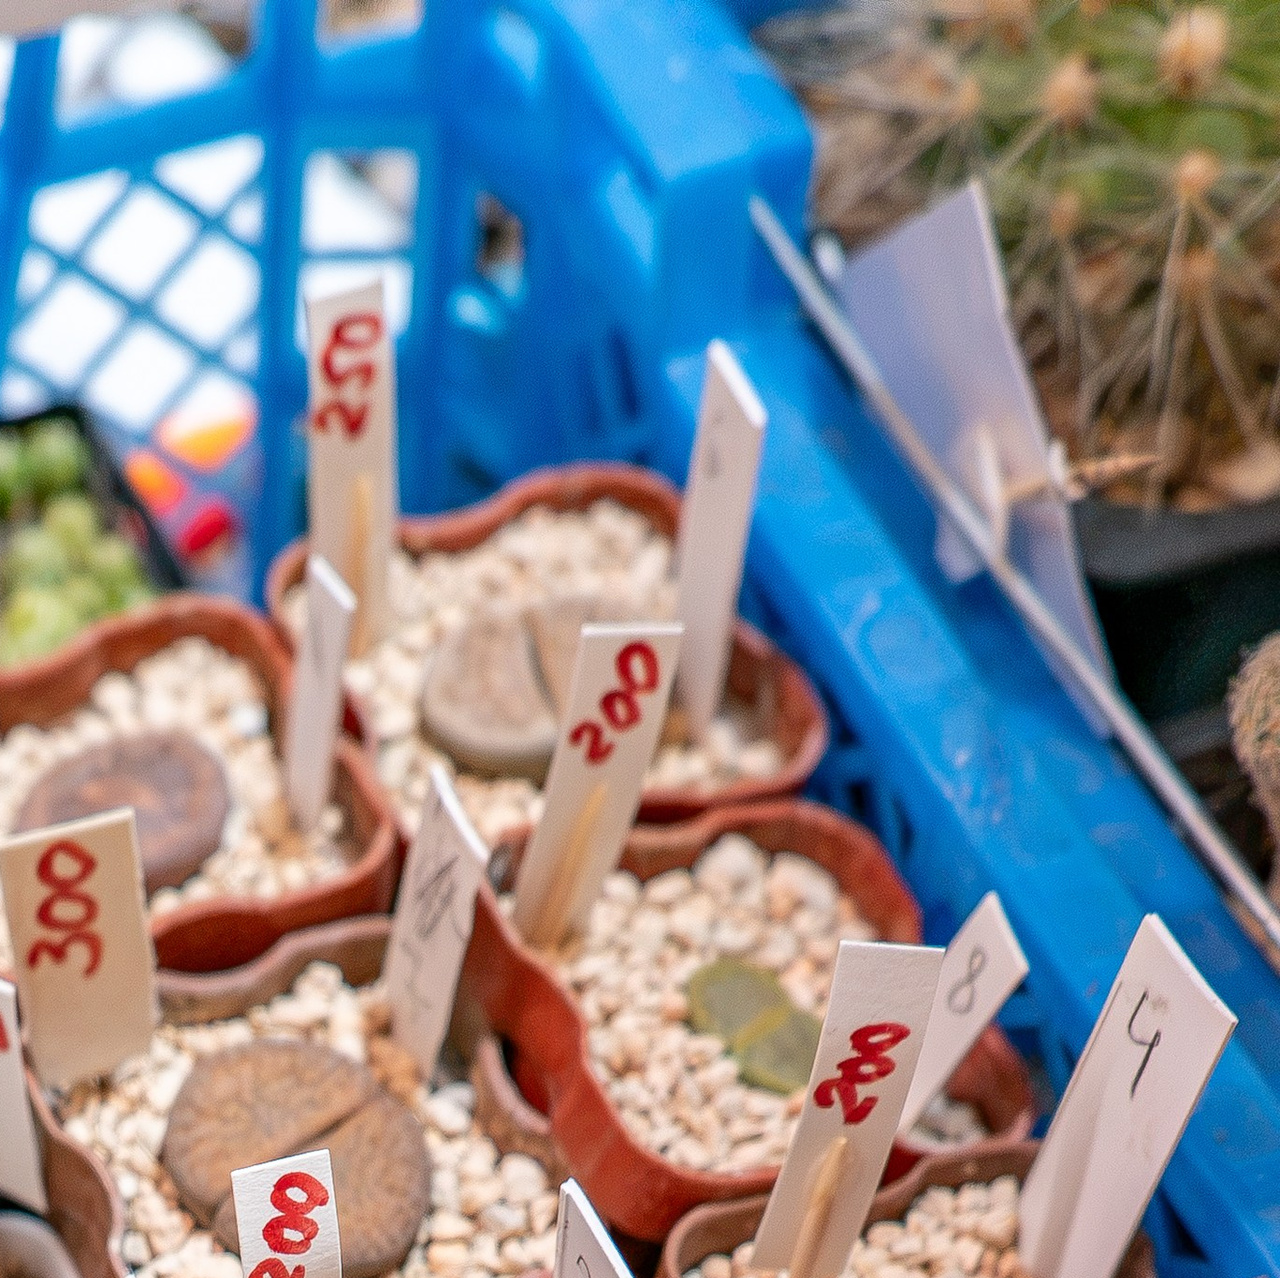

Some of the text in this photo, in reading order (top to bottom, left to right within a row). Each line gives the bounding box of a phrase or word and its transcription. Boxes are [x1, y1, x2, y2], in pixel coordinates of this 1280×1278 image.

[311, 311, 384, 442] 250
[570, 641, 660, 764] 200
[26, 840, 103, 975] 300
[814, 1022, 910, 1124] 200
